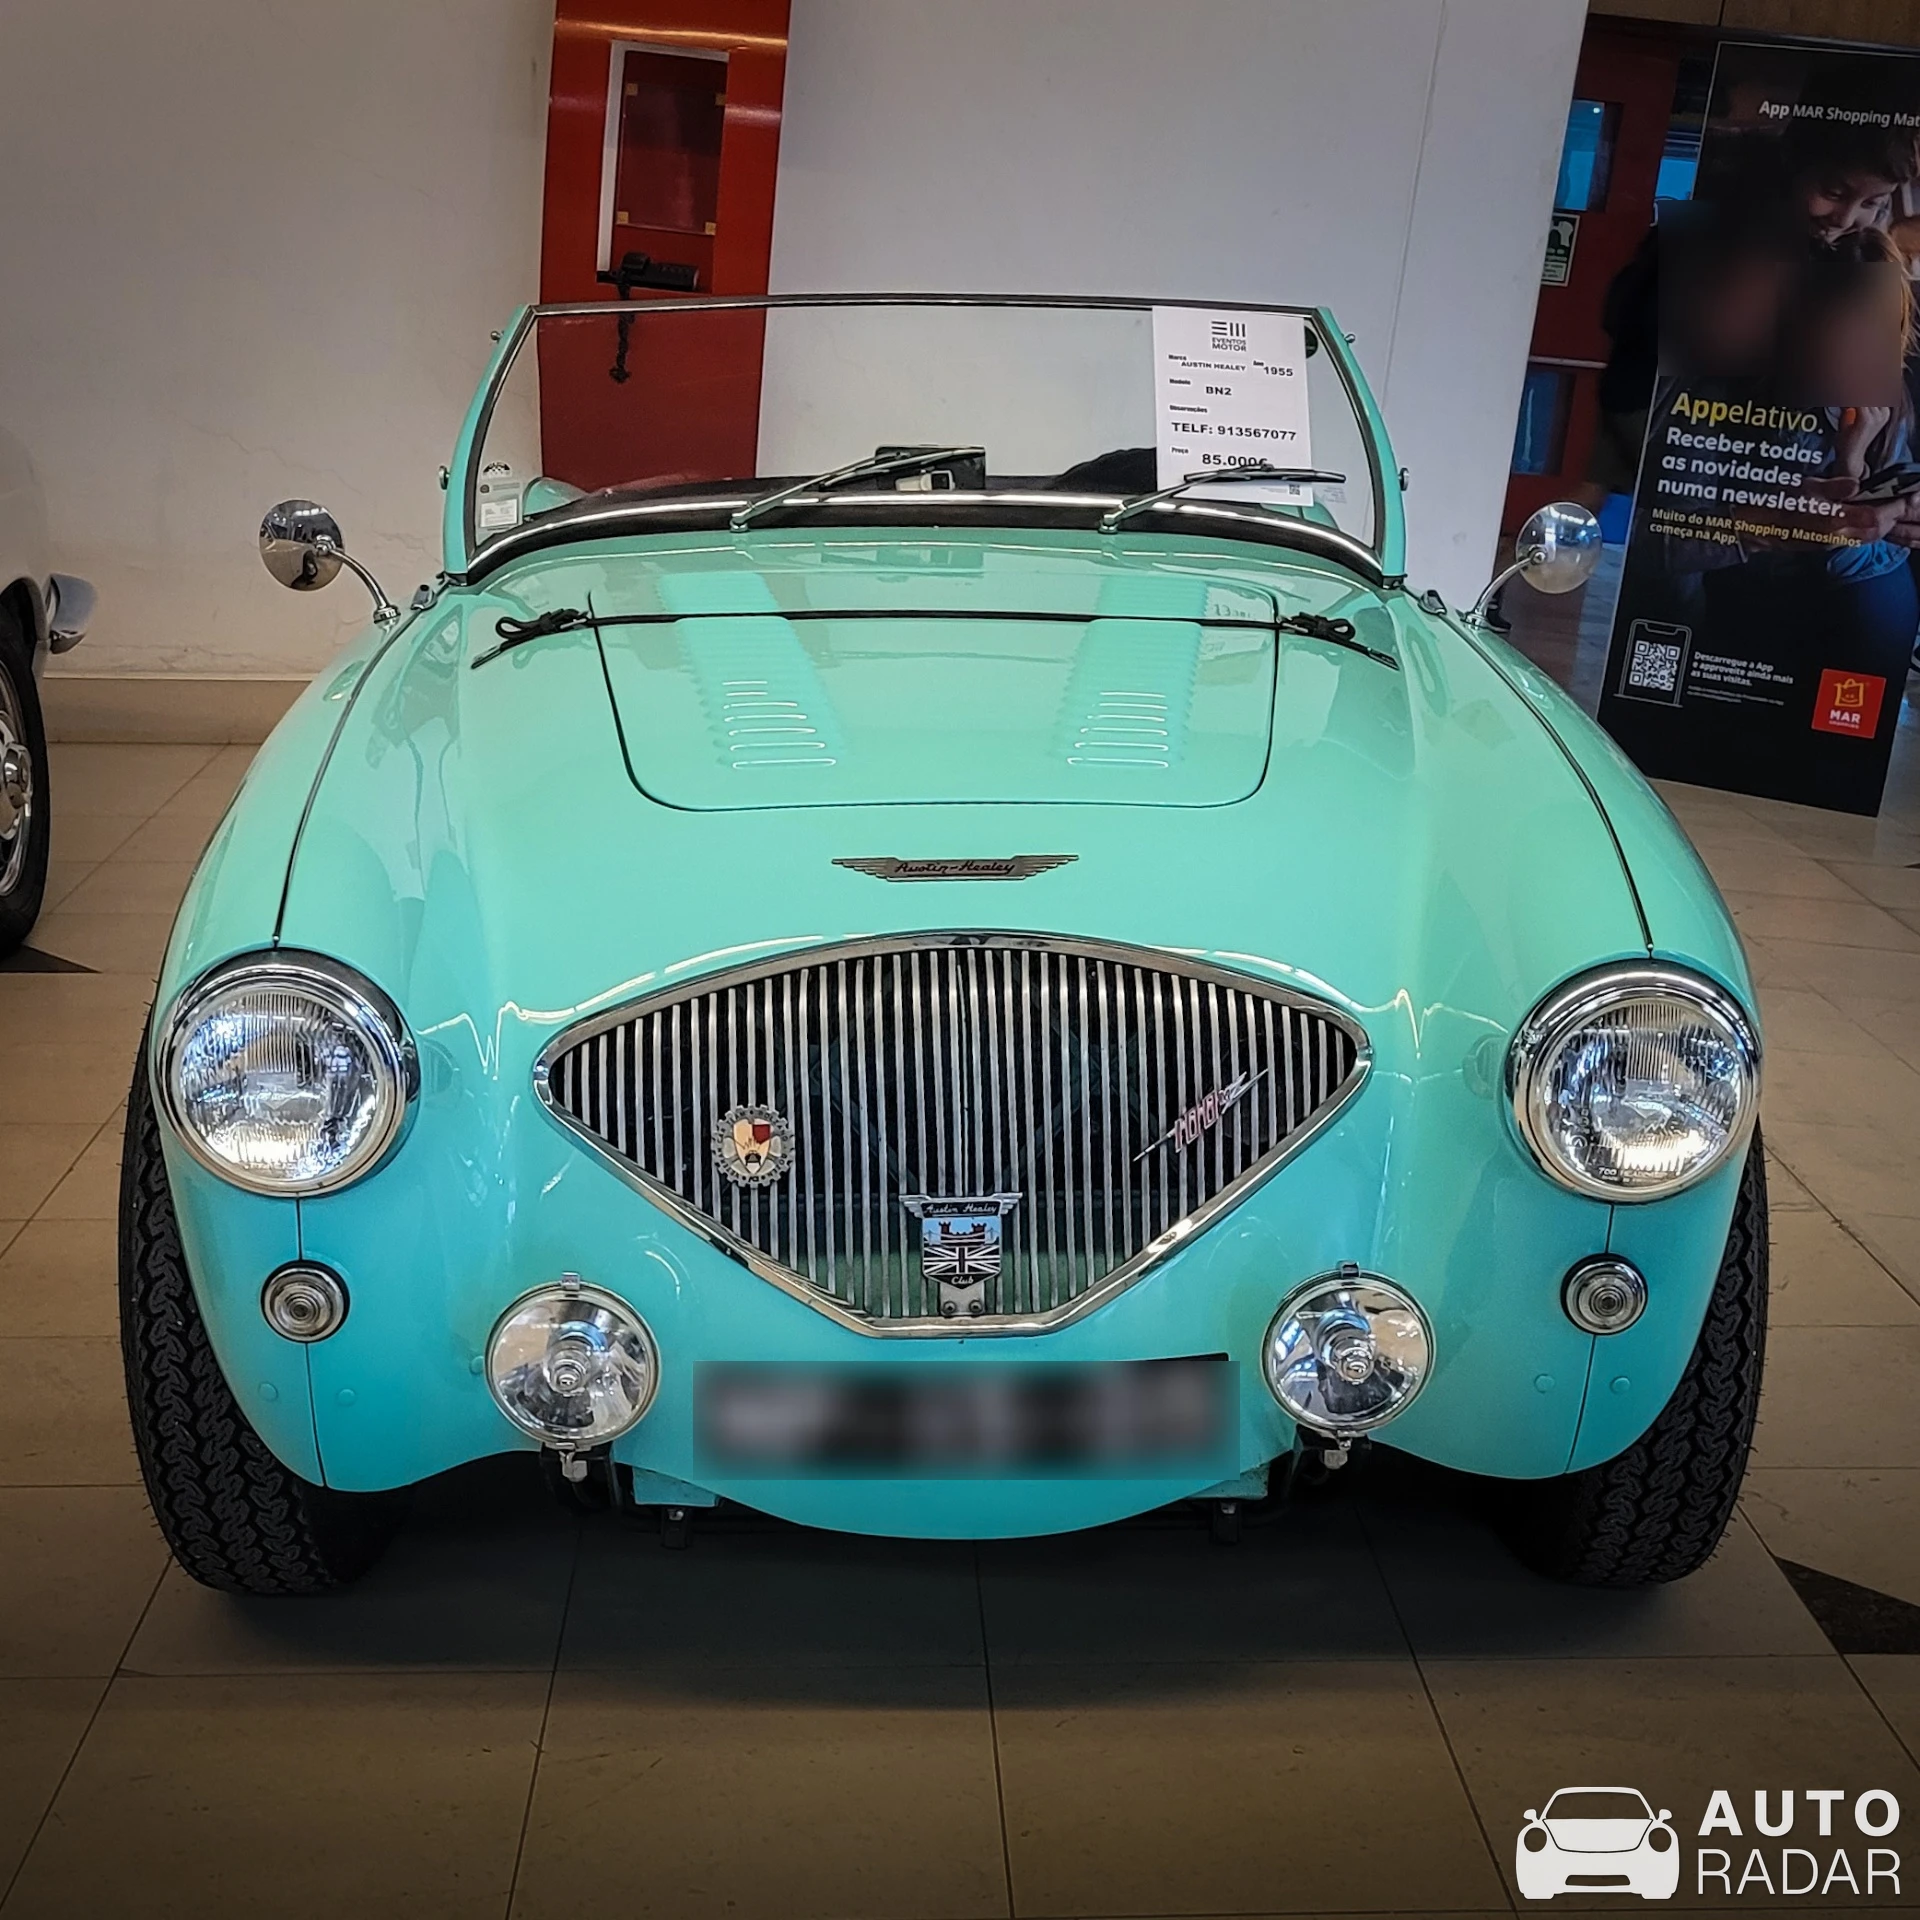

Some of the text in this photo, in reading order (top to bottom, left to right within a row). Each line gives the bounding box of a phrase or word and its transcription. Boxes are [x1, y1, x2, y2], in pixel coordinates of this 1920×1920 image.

[1759, 101, 1789, 119] App
[1793, 104, 1823, 118] MAR
[1826, 107, 1890, 127] Shopping
[1212, 337, 1246, 345] EVENTOS
[1212, 343, 1246, 351] MOTOR
[1214, 363, 1246, 372] HEALEY
[1264, 366, 1293, 376] 1955
[1206, 386, 1232, 396] BN2
[1670, 392, 1824, 434] Appelativo.
[1172, 422, 1296, 441] TELF: 913567077
[1666, 427, 1823, 465] Receber todas
[1662, 455, 1802, 487] as novidades
[1658, 478, 1846, 518] numa newsletter.
[1650, 523, 1739, 546] começa na App.
[1652, 508, 1861, 548] Muito do MAR Shopping Matosinhos
[1694, 652, 1748, 668] Descarregue
[1756, 662, 1774, 672] App
[1690, 670, 1752, 686] as suas visitas.
[1747, 670, 1771, 680] ainda
[1772, 674, 1794, 684] mais
[1830, 709, 1860, 724] MAR
[895, 860, 1015, 874] Austin-Healey
[924, 1204, 997, 1213] Austin Healey
[951, 1276, 974, 1284] Club
